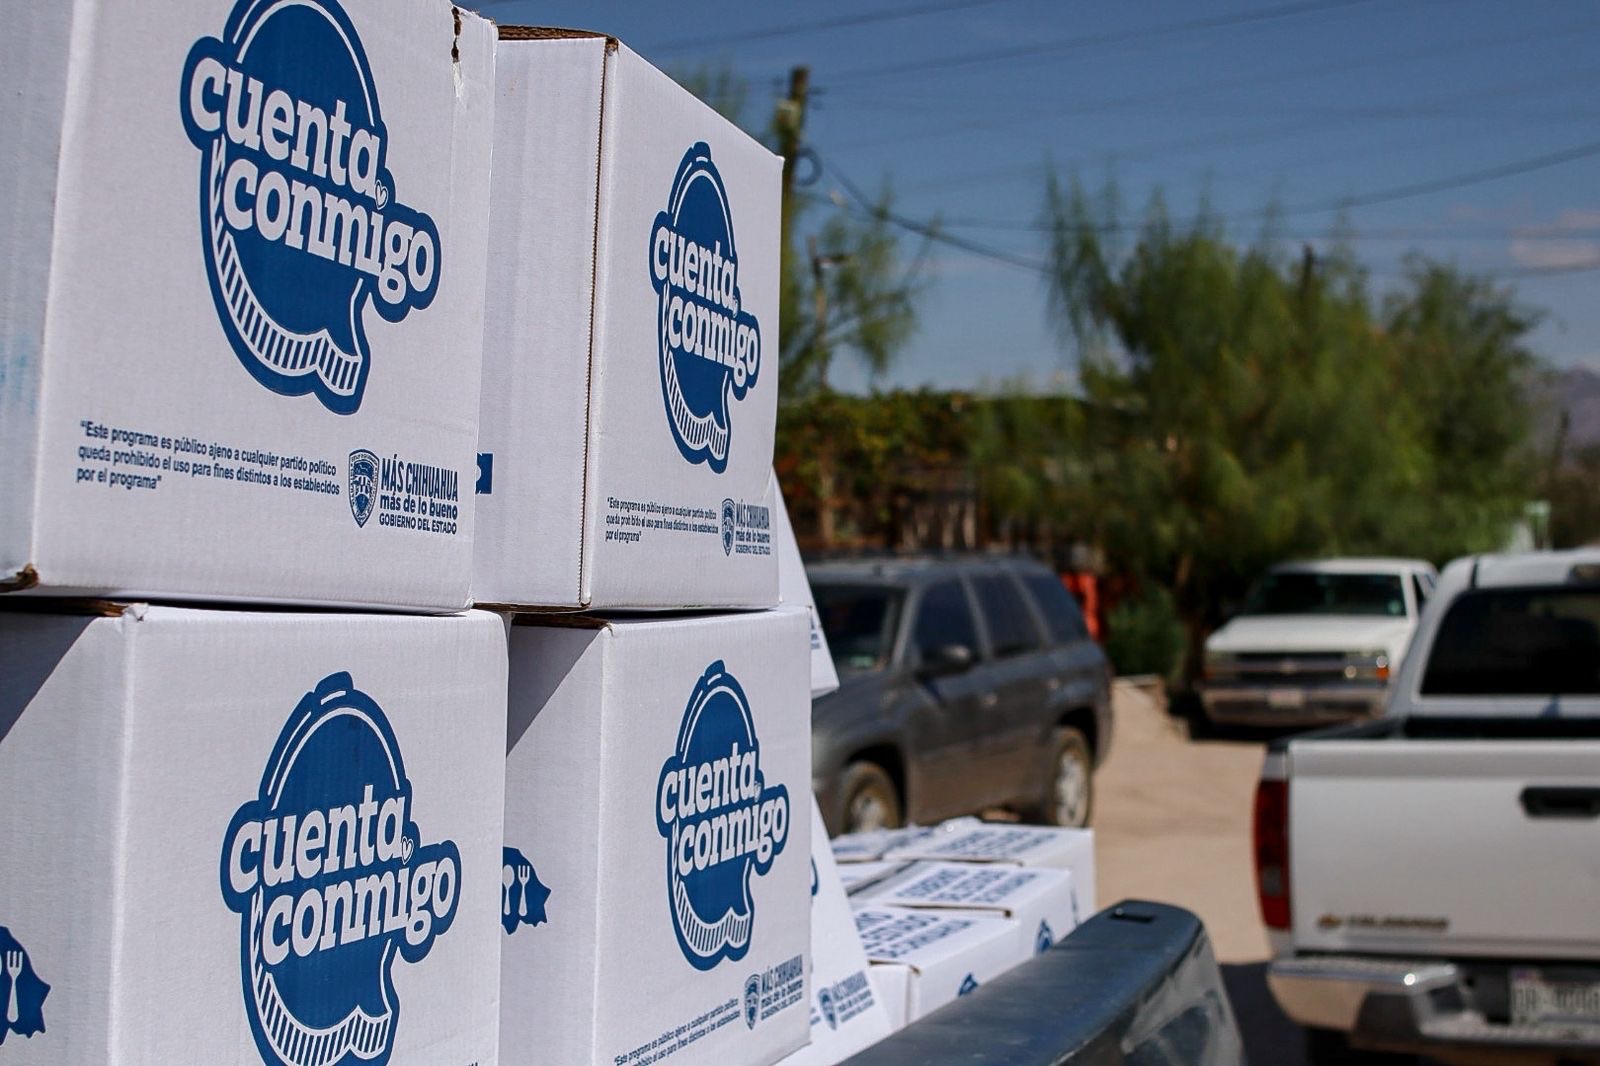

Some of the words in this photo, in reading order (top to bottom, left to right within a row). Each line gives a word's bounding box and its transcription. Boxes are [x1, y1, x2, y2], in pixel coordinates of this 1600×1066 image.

[190, 56, 381, 199] cuenta
[223, 158, 435, 304] conmigo
[653, 226, 736, 311] cuenta
[667, 295, 759, 388] conmigo
[77, 468, 96, 483] por
[98, 468, 108, 482] el
[79, 446, 111, 461] queda
[114, 450, 160, 468] prohibido
[163, 456, 171, 470] el
[174, 460, 190, 473] uso
[192, 462, 211, 477] para
[213, 463, 234, 480] fines
[236, 467, 271, 486] distintos
[273, 475, 278, 486] a
[280, 473, 292, 488] los
[293, 476, 340, 495] establecidos
[112, 429, 159, 447] programa
[160, 437, 172, 450] es
[174, 437, 208, 454] público
[209, 443, 232, 460] ajeno
[234, 449, 239, 461] a
[241, 450, 278, 467] cualquier
[280, 456, 307, 471] partido
[309, 459, 336, 476] político
[381, 454, 404, 493] MÁS
[406, 463, 458, 502] CHIHUAHUA
[379, 513, 416, 530] GOBIERNO
[418, 518, 430, 531] DEL
[431, 521, 457, 535] ESTADO
[380, 491, 401, 511] más
[403, 494, 415, 514] de
[418, 497, 427, 515] lo
[429, 500, 458, 520] bueno
[660, 742, 756, 824] cuenta
[230, 784, 406, 893] cuenta
[678, 796, 787, 877] conmigo
[262, 857, 456, 965] conmigo
